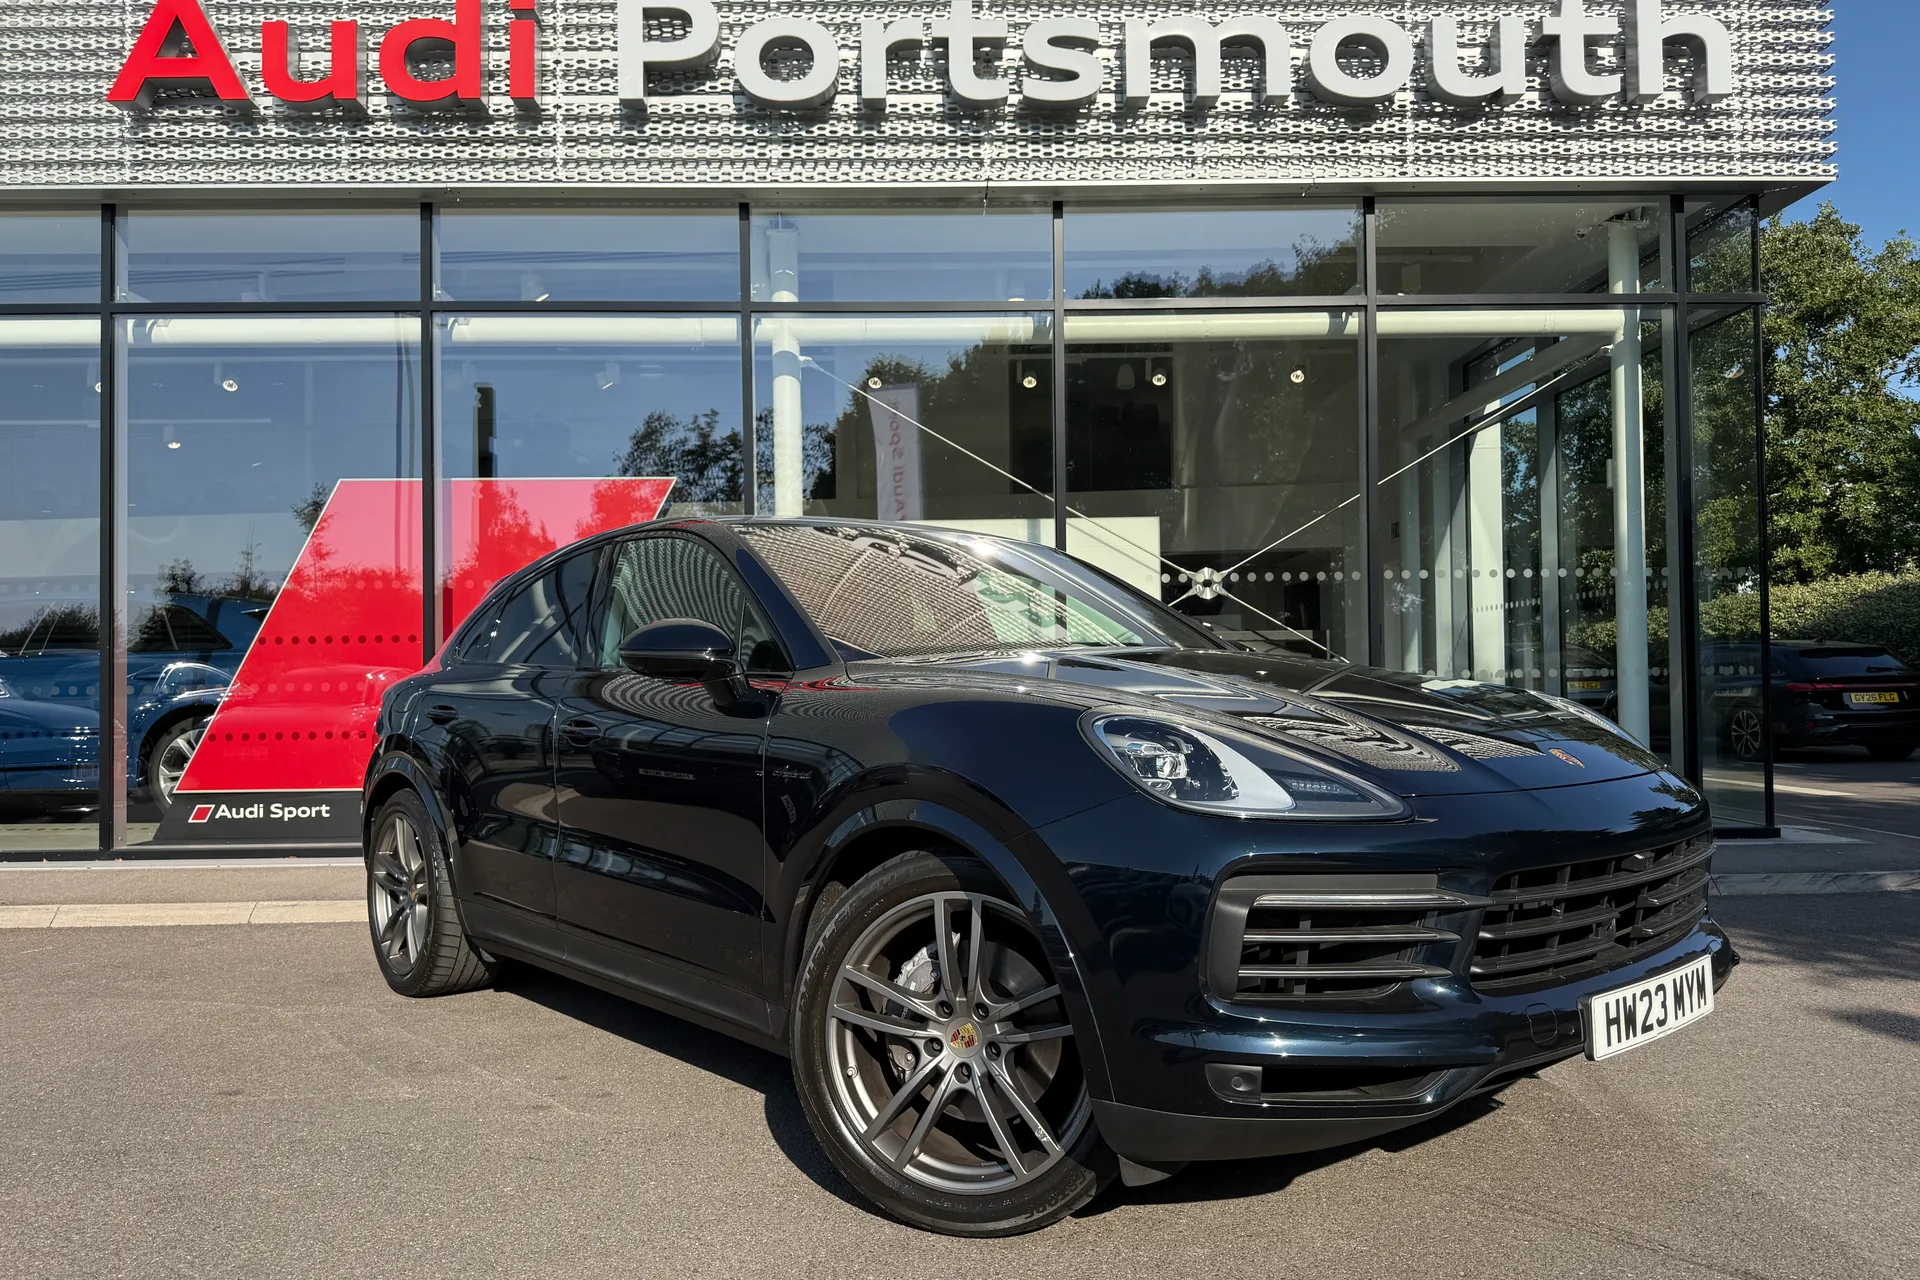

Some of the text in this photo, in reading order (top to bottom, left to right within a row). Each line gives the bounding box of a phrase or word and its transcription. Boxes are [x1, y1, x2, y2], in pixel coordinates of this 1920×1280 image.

[106, 0, 1734, 107] Audi Portsmouth
[1854, 693, 1895, 702] GY26 FLG
[214, 803, 330, 821] Audi Sport
[1605, 965, 1707, 1047] HW23 MYM
